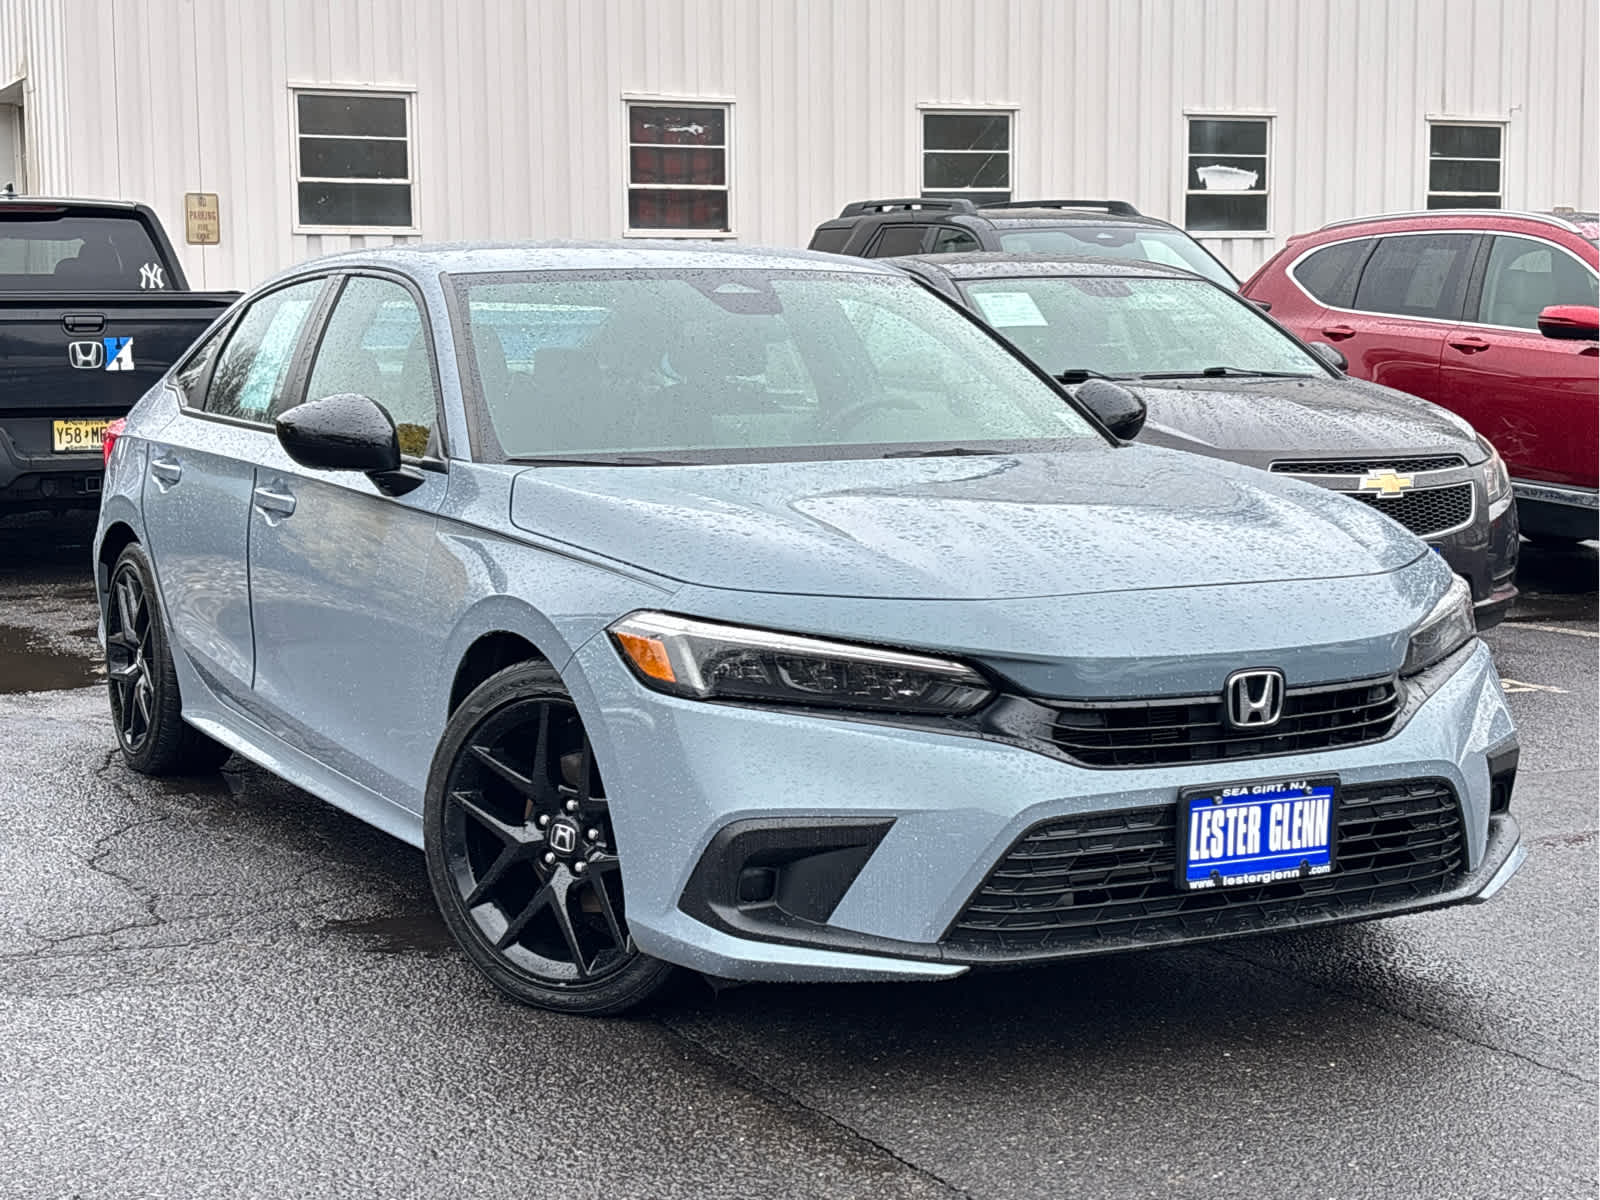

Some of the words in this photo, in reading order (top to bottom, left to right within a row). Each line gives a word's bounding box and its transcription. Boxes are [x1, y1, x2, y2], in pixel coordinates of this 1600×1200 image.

[190, 211, 217, 220] PARKING
[139, 263, 165, 289] NY
[1222, 787, 1249, 797] SEA
[1189, 805, 1262, 861] LESTER
[1268, 798, 1331, 852] GLENN
[1308, 865, 1331, 875] .com
